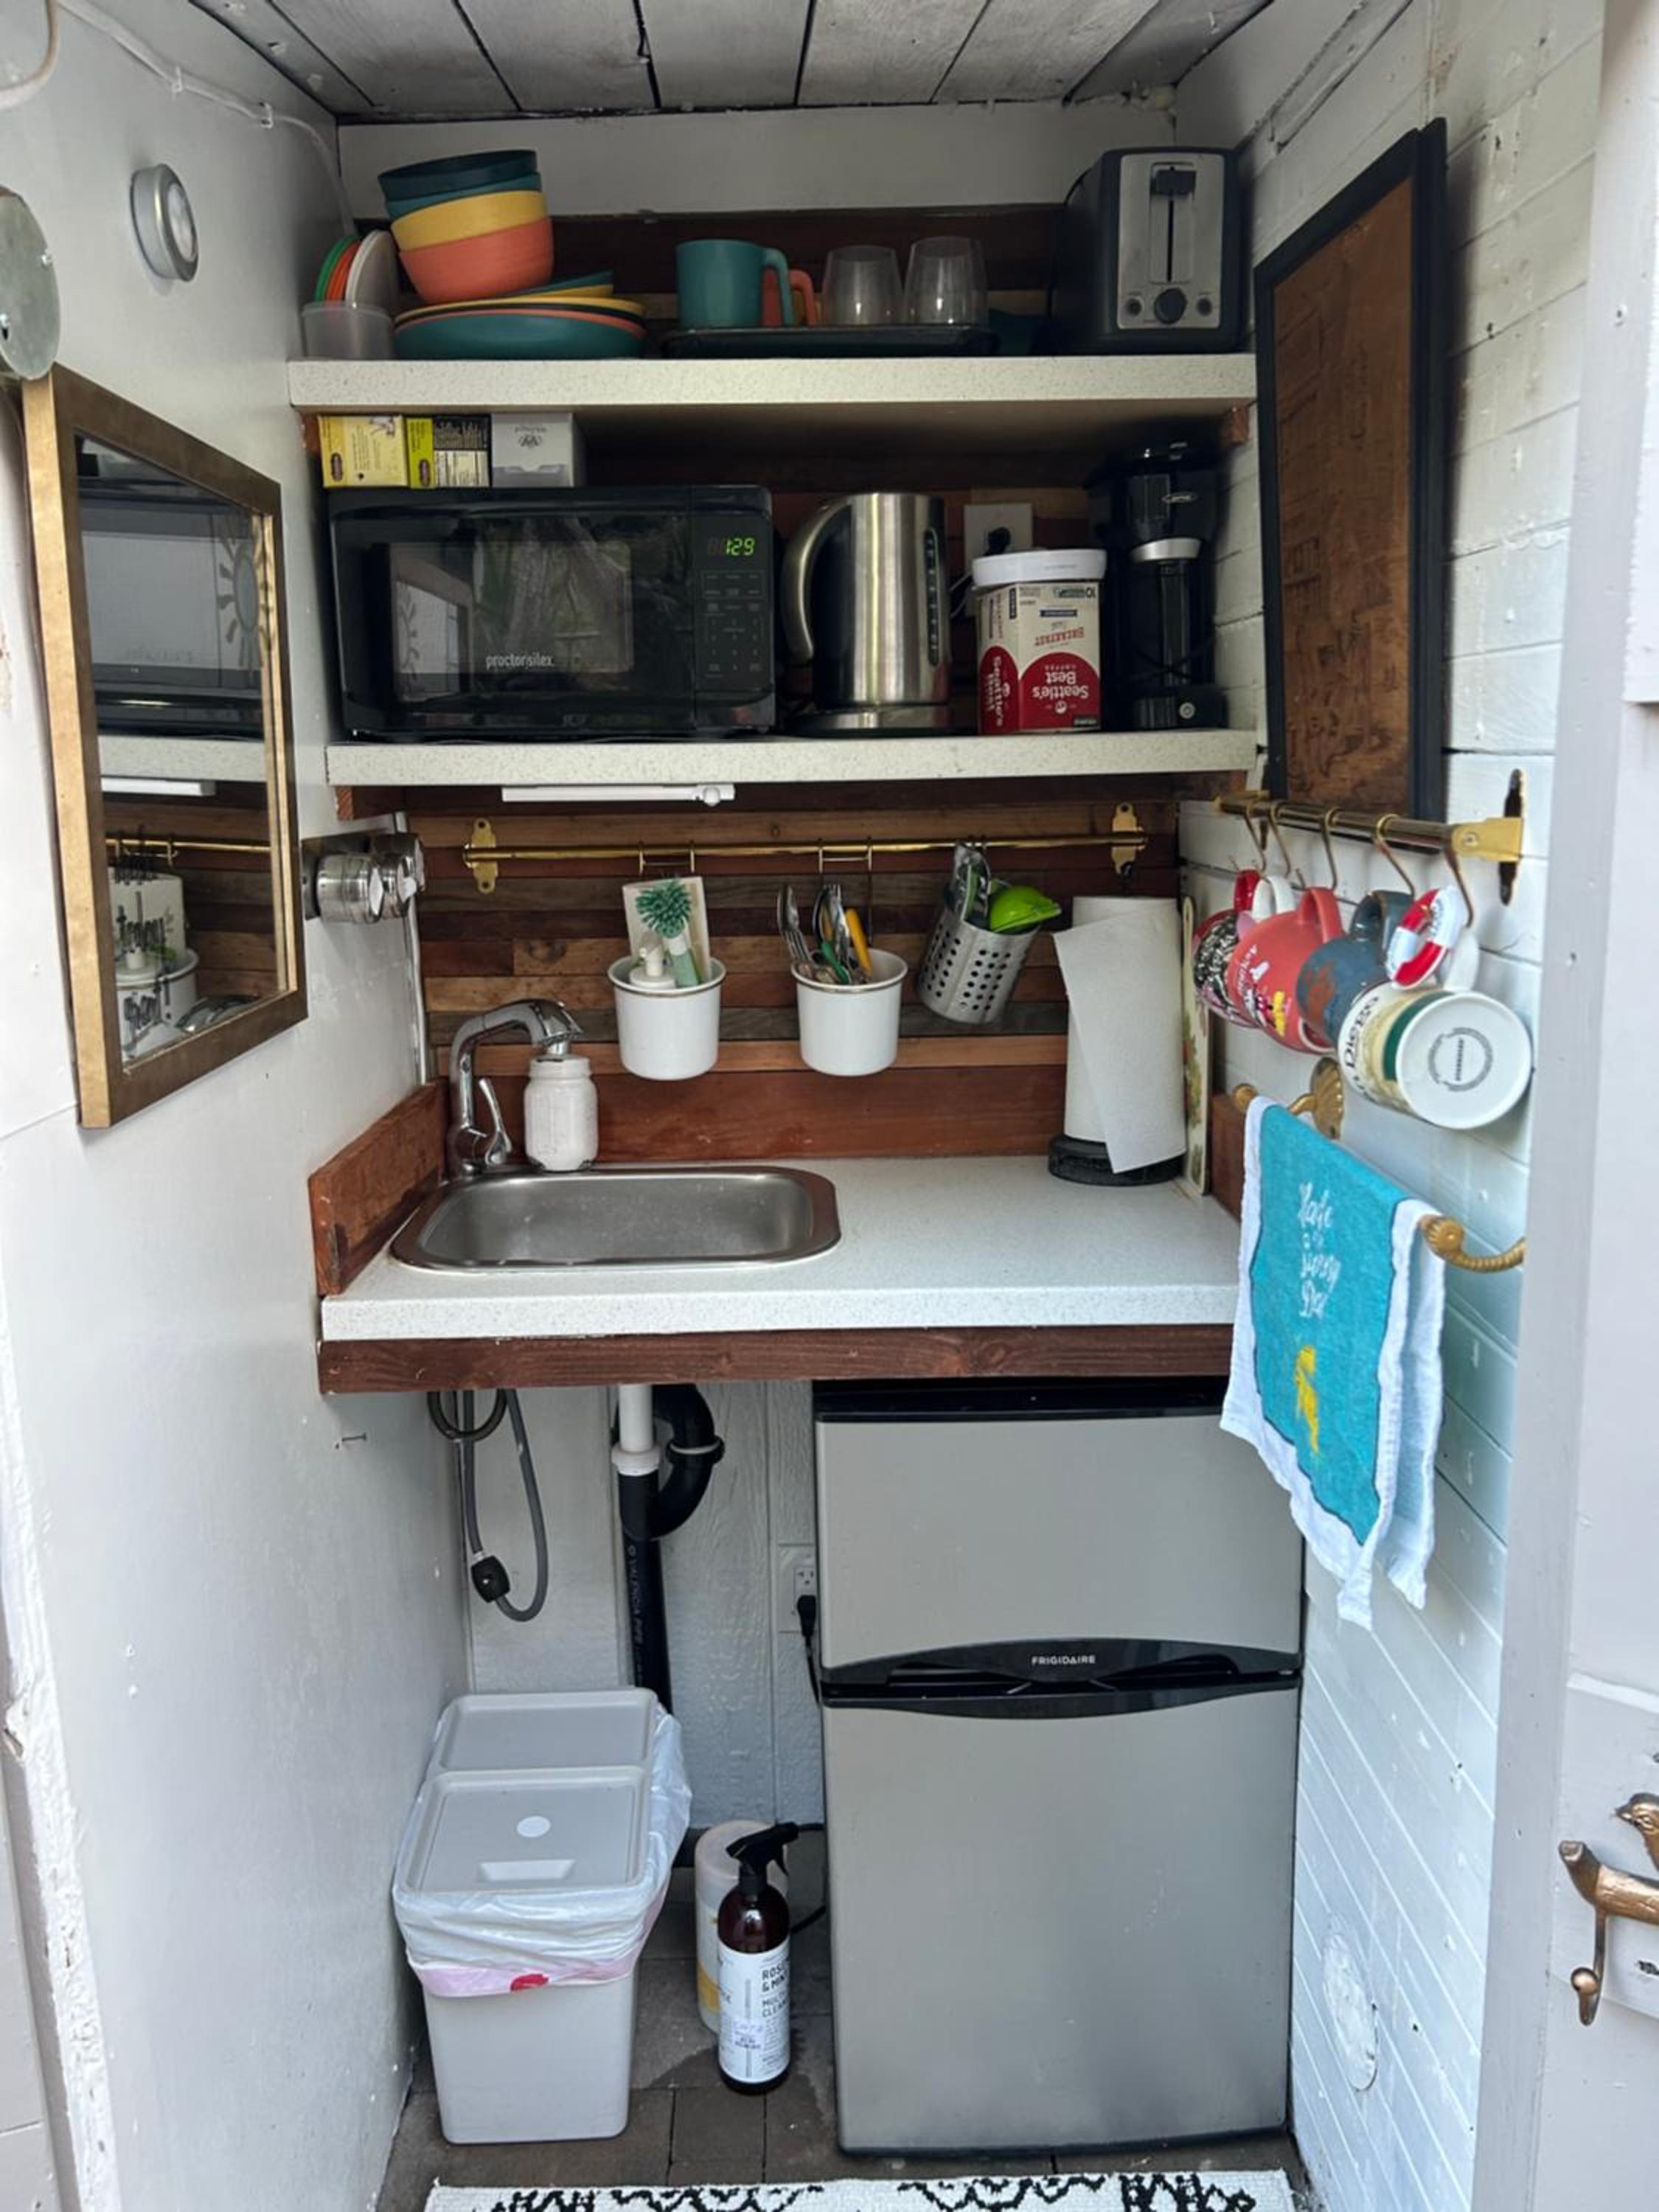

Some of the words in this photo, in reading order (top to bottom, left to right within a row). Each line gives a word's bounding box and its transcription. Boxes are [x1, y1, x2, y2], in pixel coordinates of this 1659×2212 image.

[1046, 672, 1077, 684] Best
[1032, 685, 1089, 700] Seattle's
[1032, 1654, 1096, 1666] FRIGIDAIRE
